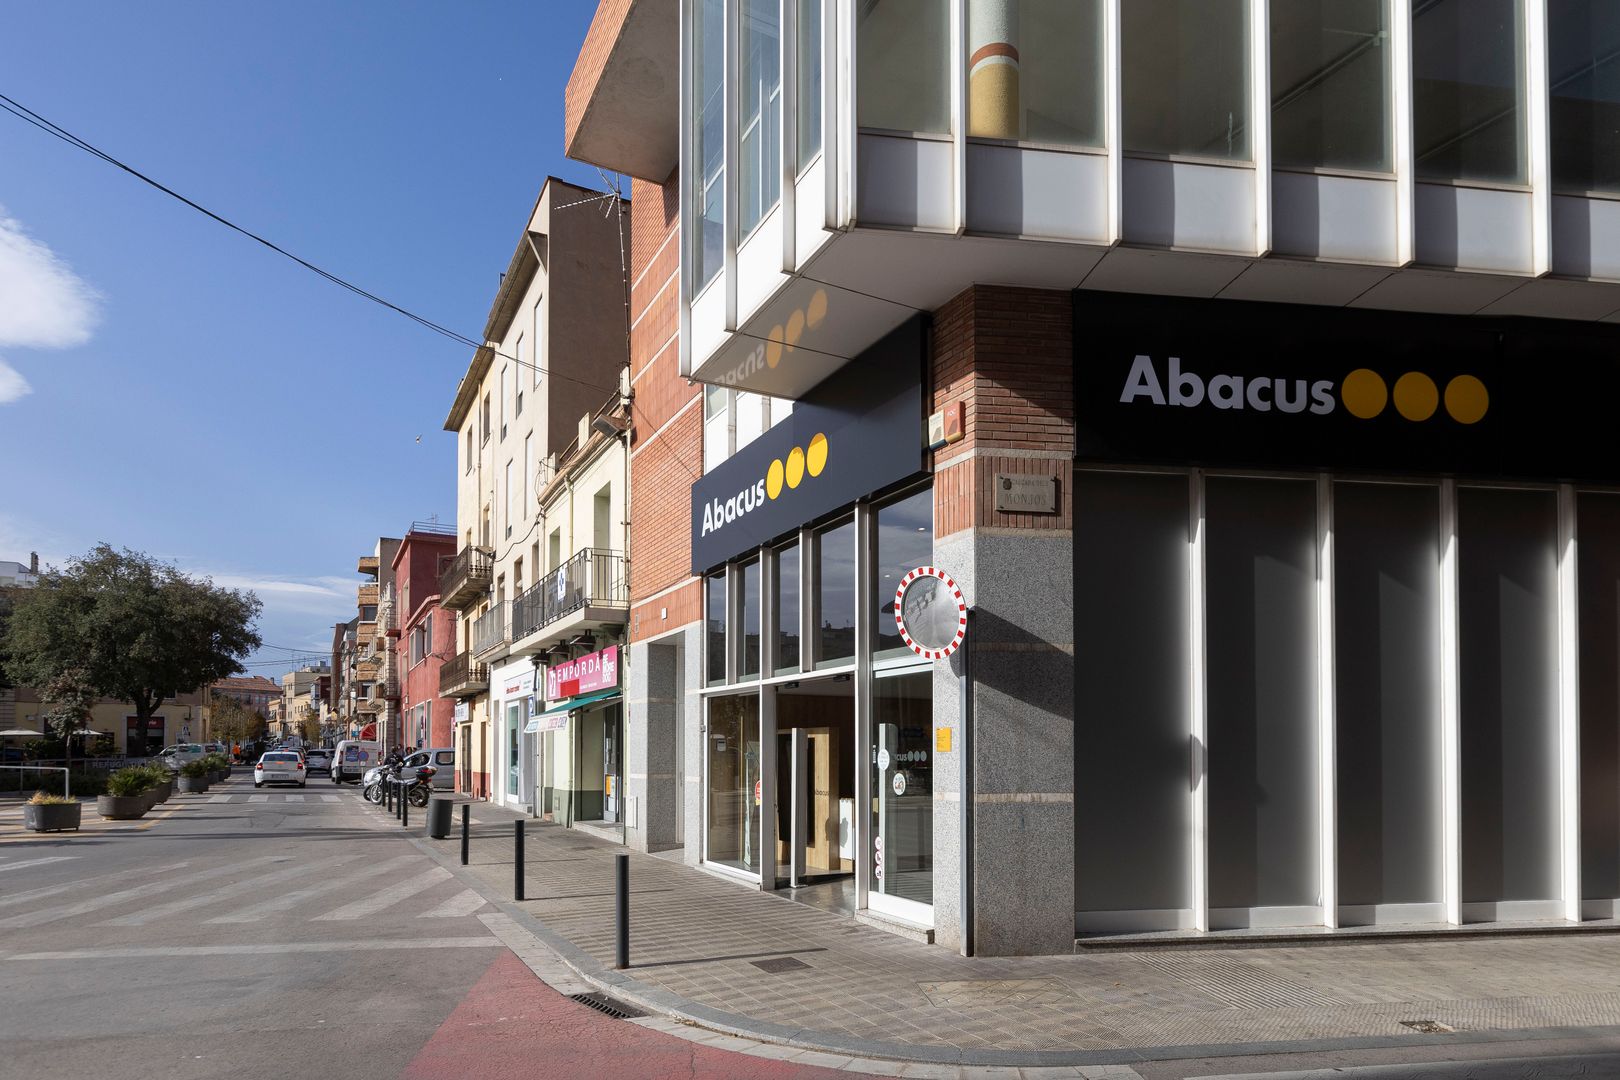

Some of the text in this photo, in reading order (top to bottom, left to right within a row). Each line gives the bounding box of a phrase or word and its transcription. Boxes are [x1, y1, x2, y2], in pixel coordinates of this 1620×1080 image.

[1119, 354, 1336, 416] Abacus
[701, 477, 766, 538] Abacus
[557, 653, 601, 683] EMPORDÀ
